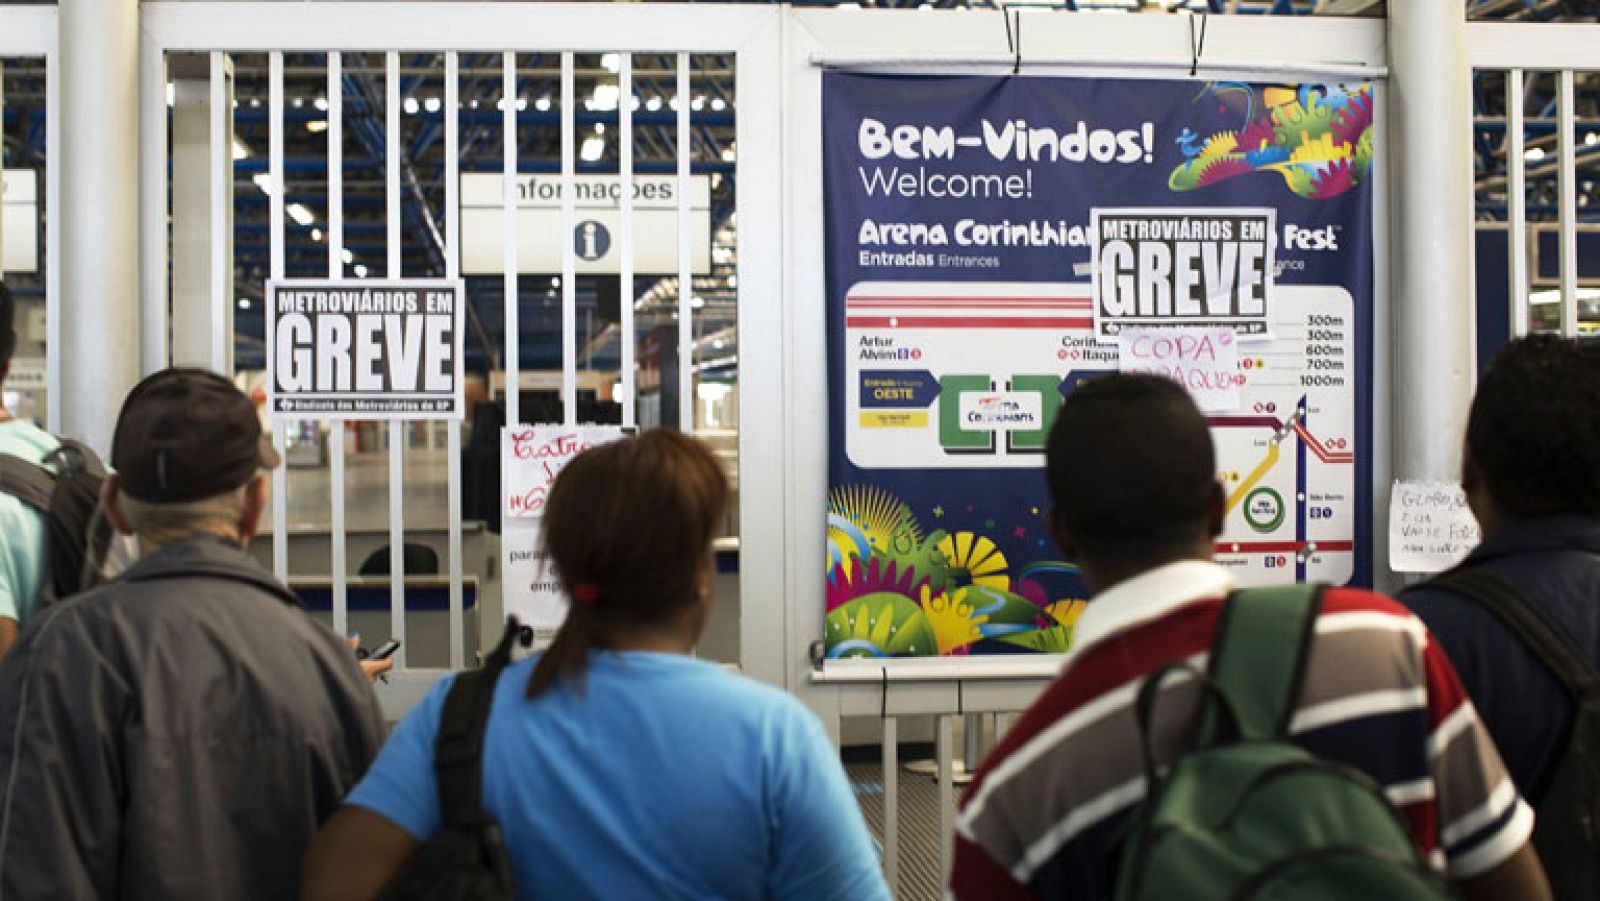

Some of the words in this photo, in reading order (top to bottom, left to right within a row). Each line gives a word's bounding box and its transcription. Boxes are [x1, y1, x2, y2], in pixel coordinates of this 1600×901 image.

[858, 117, 1154, 165] Bem-Vindos!
[859, 166, 1033, 198] Welcome!
[503, 177, 673, 206] nformaçes
[858, 218, 949, 246] Arena
[1102, 217, 1232, 240] METROVIÁRIOS
[1240, 220, 1266, 240] EM
[859, 250, 934, 266] Entradas
[938, 254, 1000, 268] Entrances
[1101, 240, 1266, 317] GREVE
[278, 287, 418, 313] METROVIÁRIOS
[426, 291, 453, 313] EM
[1306, 315, 1345, 326] 300m
[859, 335, 895, 347] Artur
[1306, 330, 1345, 341] 300m
[276, 313, 453, 393] GREVE
[859, 348, 897, 360] Alvim
[1081, 349, 1120, 363] Itaqu
[1131, 332, 1217, 362] COPA
[1305, 345, 1345, 356] 600m
[1305, 359, 1345, 370] 700m
[1300, 375, 1345, 387] 1000m
[873, 388, 914, 400] OESTE
